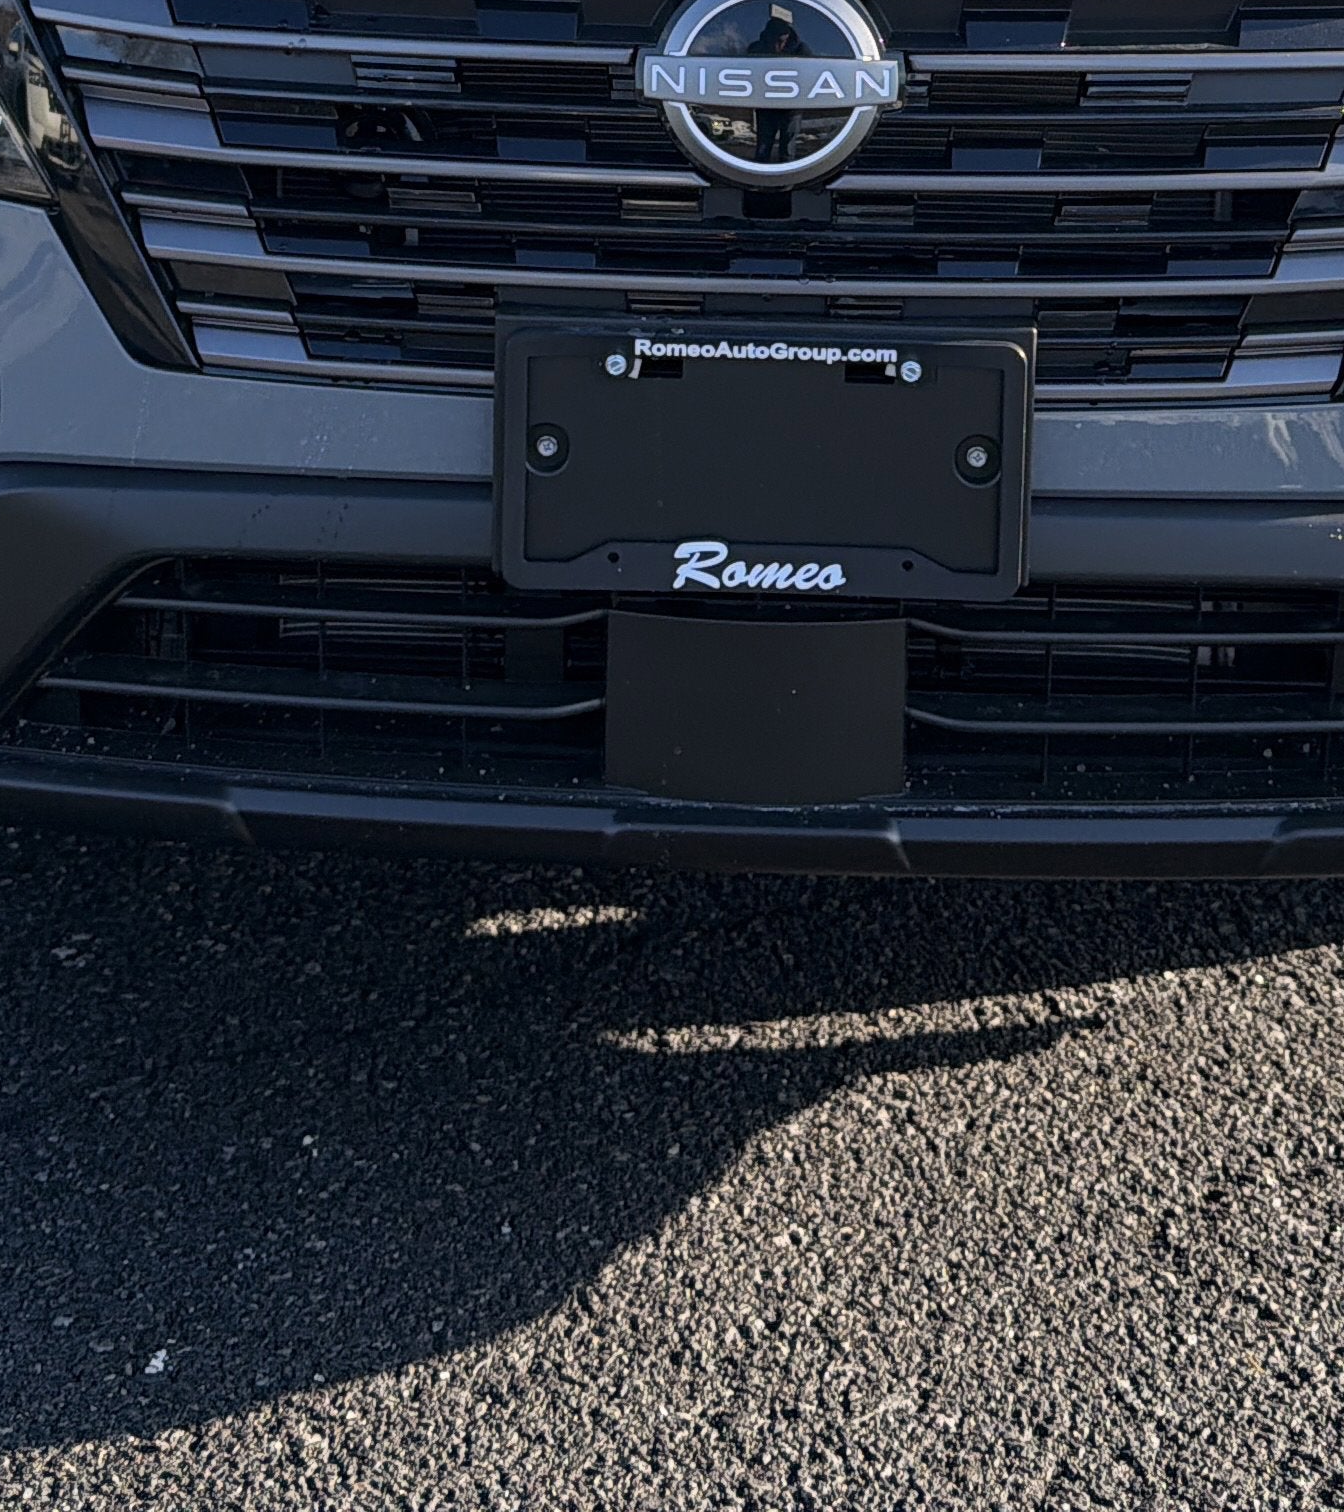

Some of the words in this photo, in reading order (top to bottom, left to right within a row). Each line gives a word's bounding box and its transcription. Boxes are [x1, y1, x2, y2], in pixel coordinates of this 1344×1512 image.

[651, 64, 890, 99] NISSAN
[634, 338, 898, 365] RomeoAutoGroup.com
[672, 541, 847, 591] Romeo
